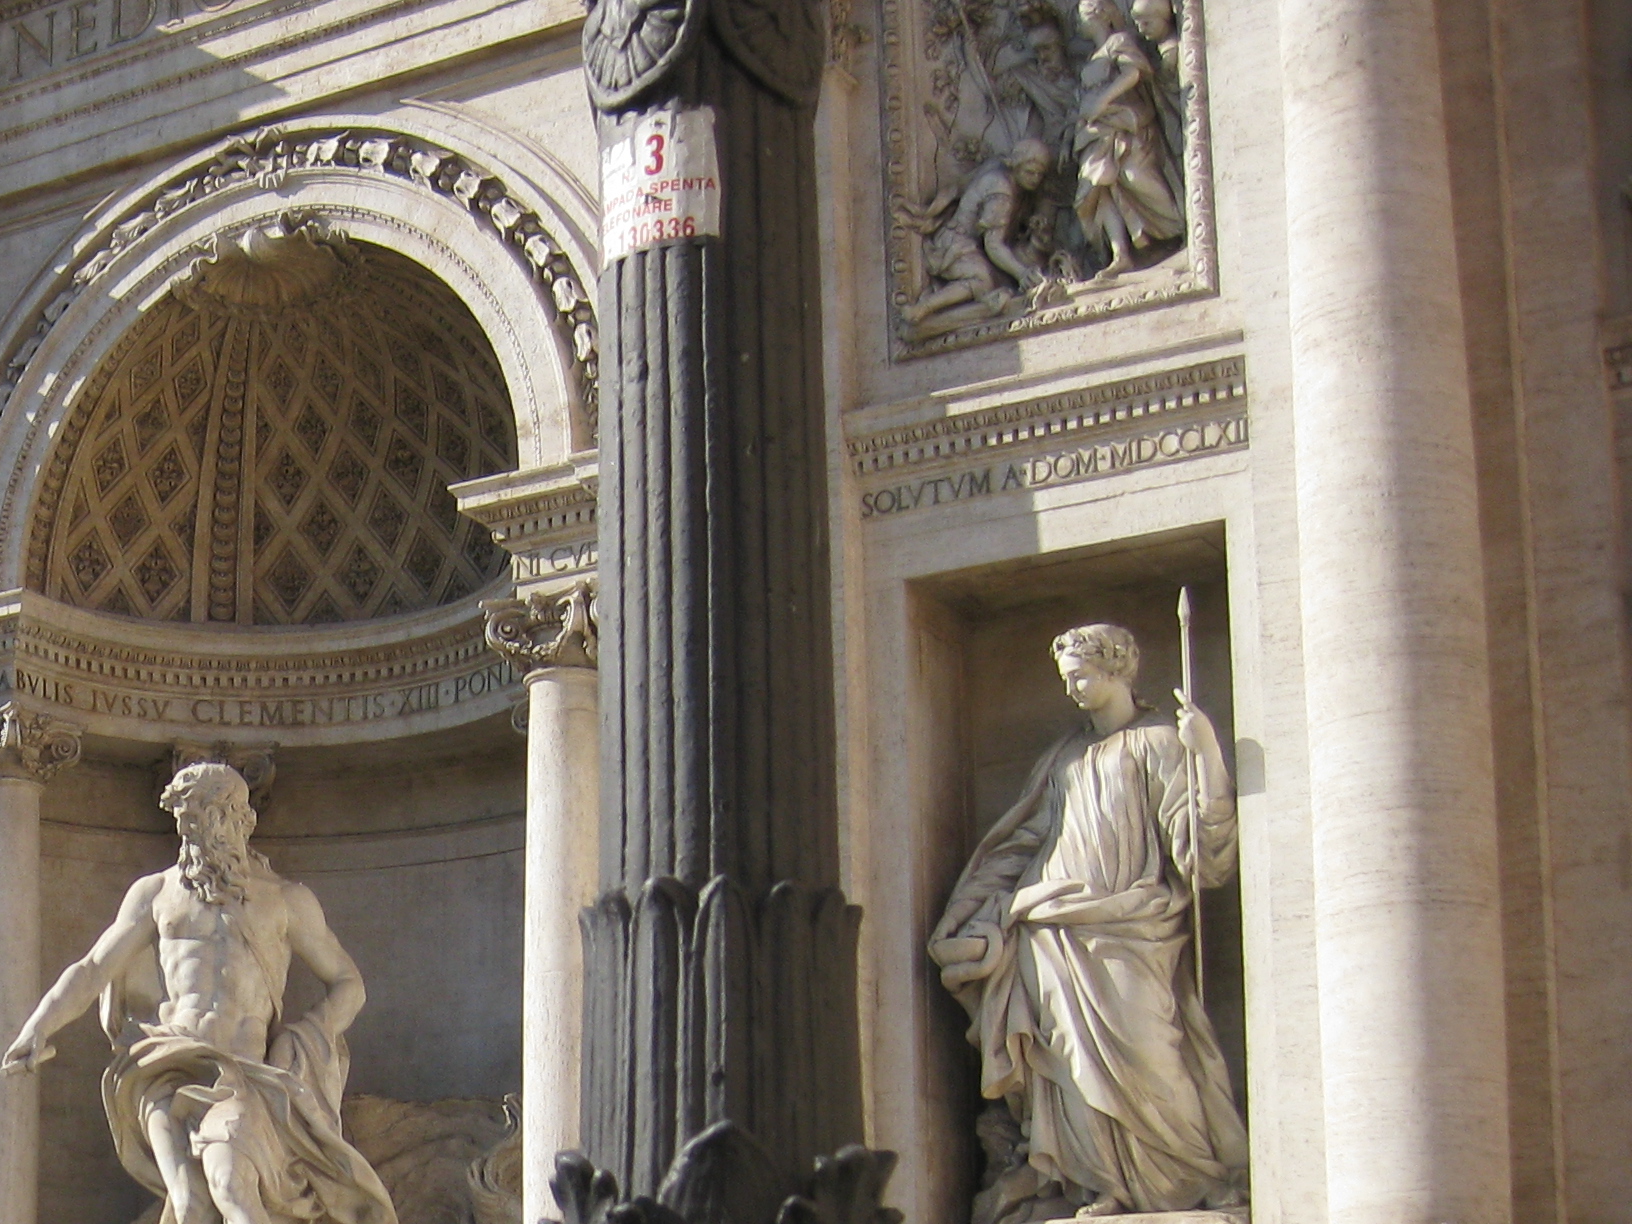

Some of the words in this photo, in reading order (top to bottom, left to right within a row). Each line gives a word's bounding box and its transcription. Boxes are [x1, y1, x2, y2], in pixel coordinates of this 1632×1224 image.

[644, 133, 665, 175] 3
[604, 186, 645, 216] MPADA
[649, 177, 717, 195] SPENTA
[861, 471, 993, 520] SOLVTVM
[90, 688, 171, 720] IVSSV
